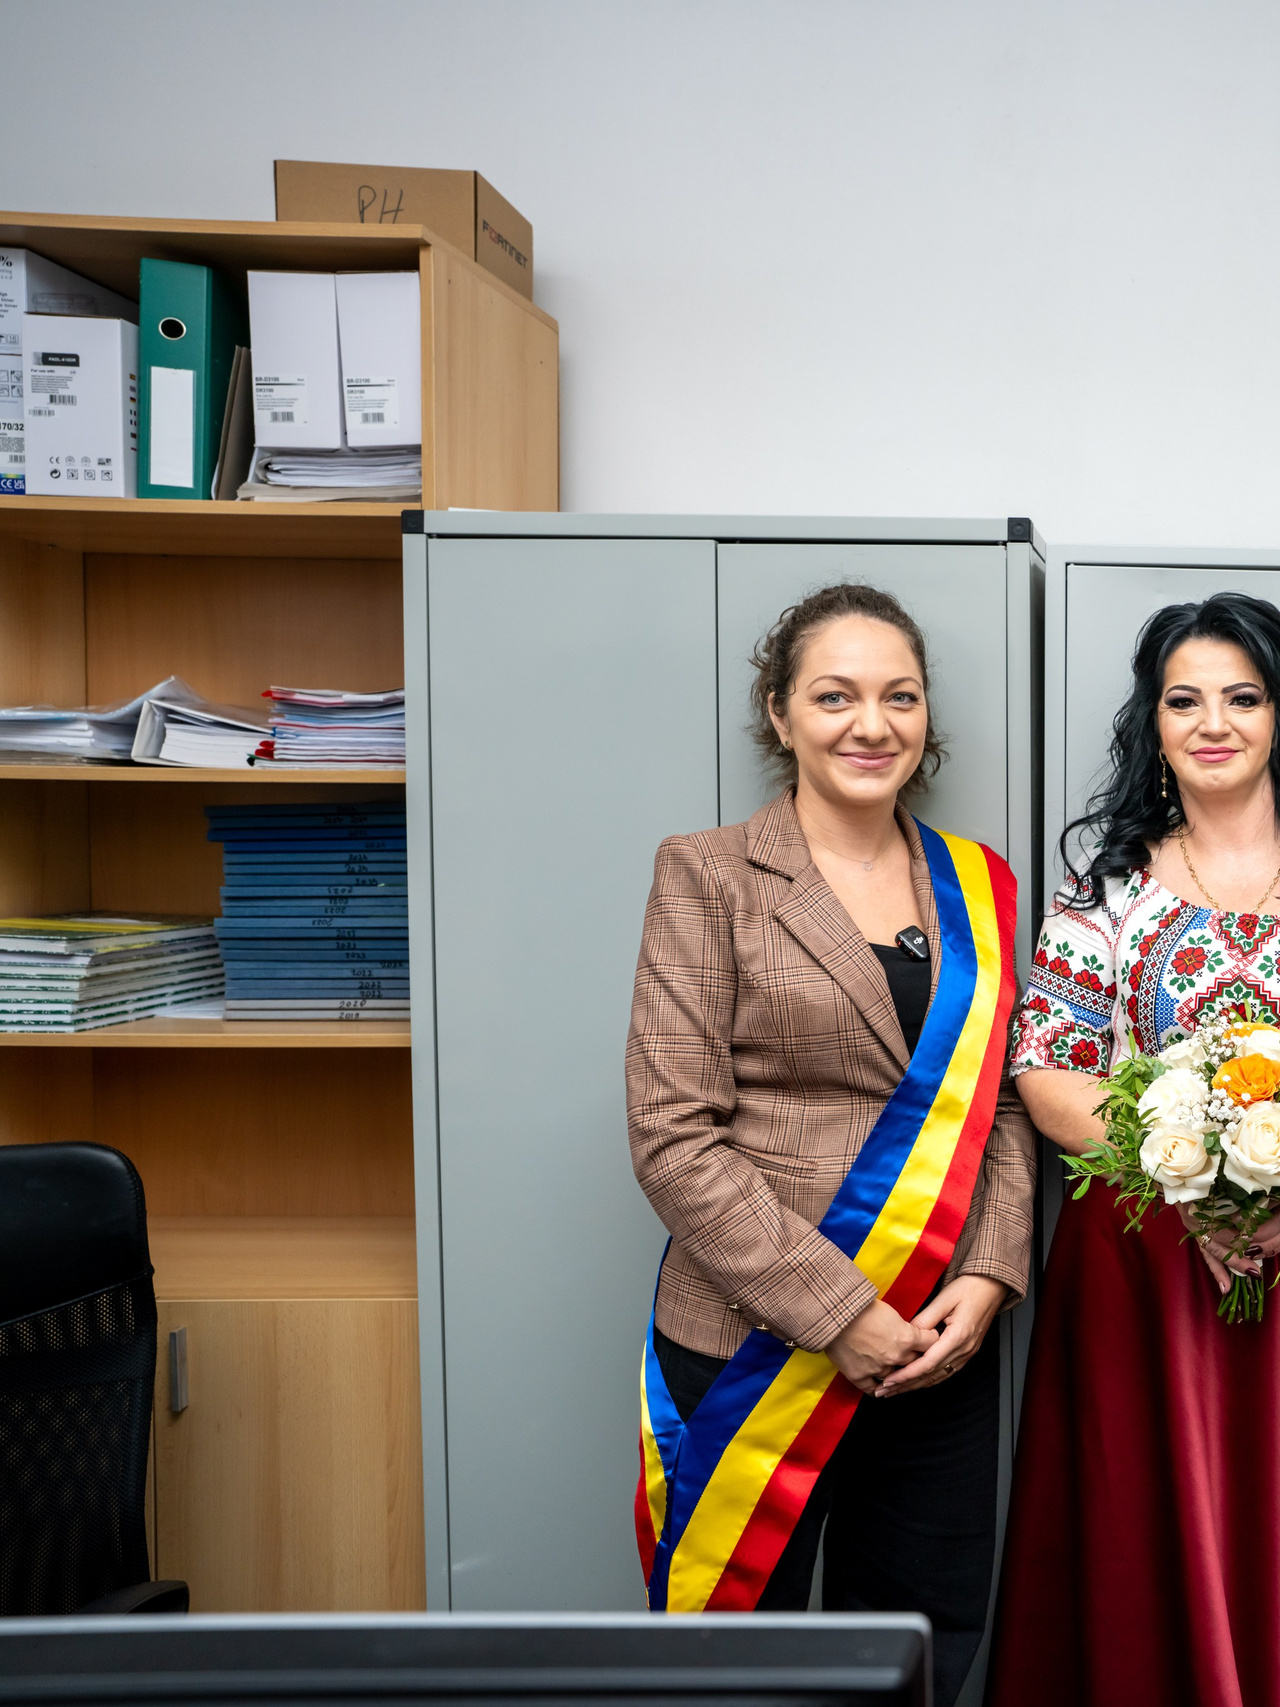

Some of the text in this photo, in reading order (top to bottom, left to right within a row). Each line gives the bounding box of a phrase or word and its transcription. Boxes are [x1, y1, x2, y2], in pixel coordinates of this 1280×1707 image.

[358, 185, 405, 224] PH
[482, 219, 529, 270] FORTINET
[338, 999, 367, 1009] 2020
